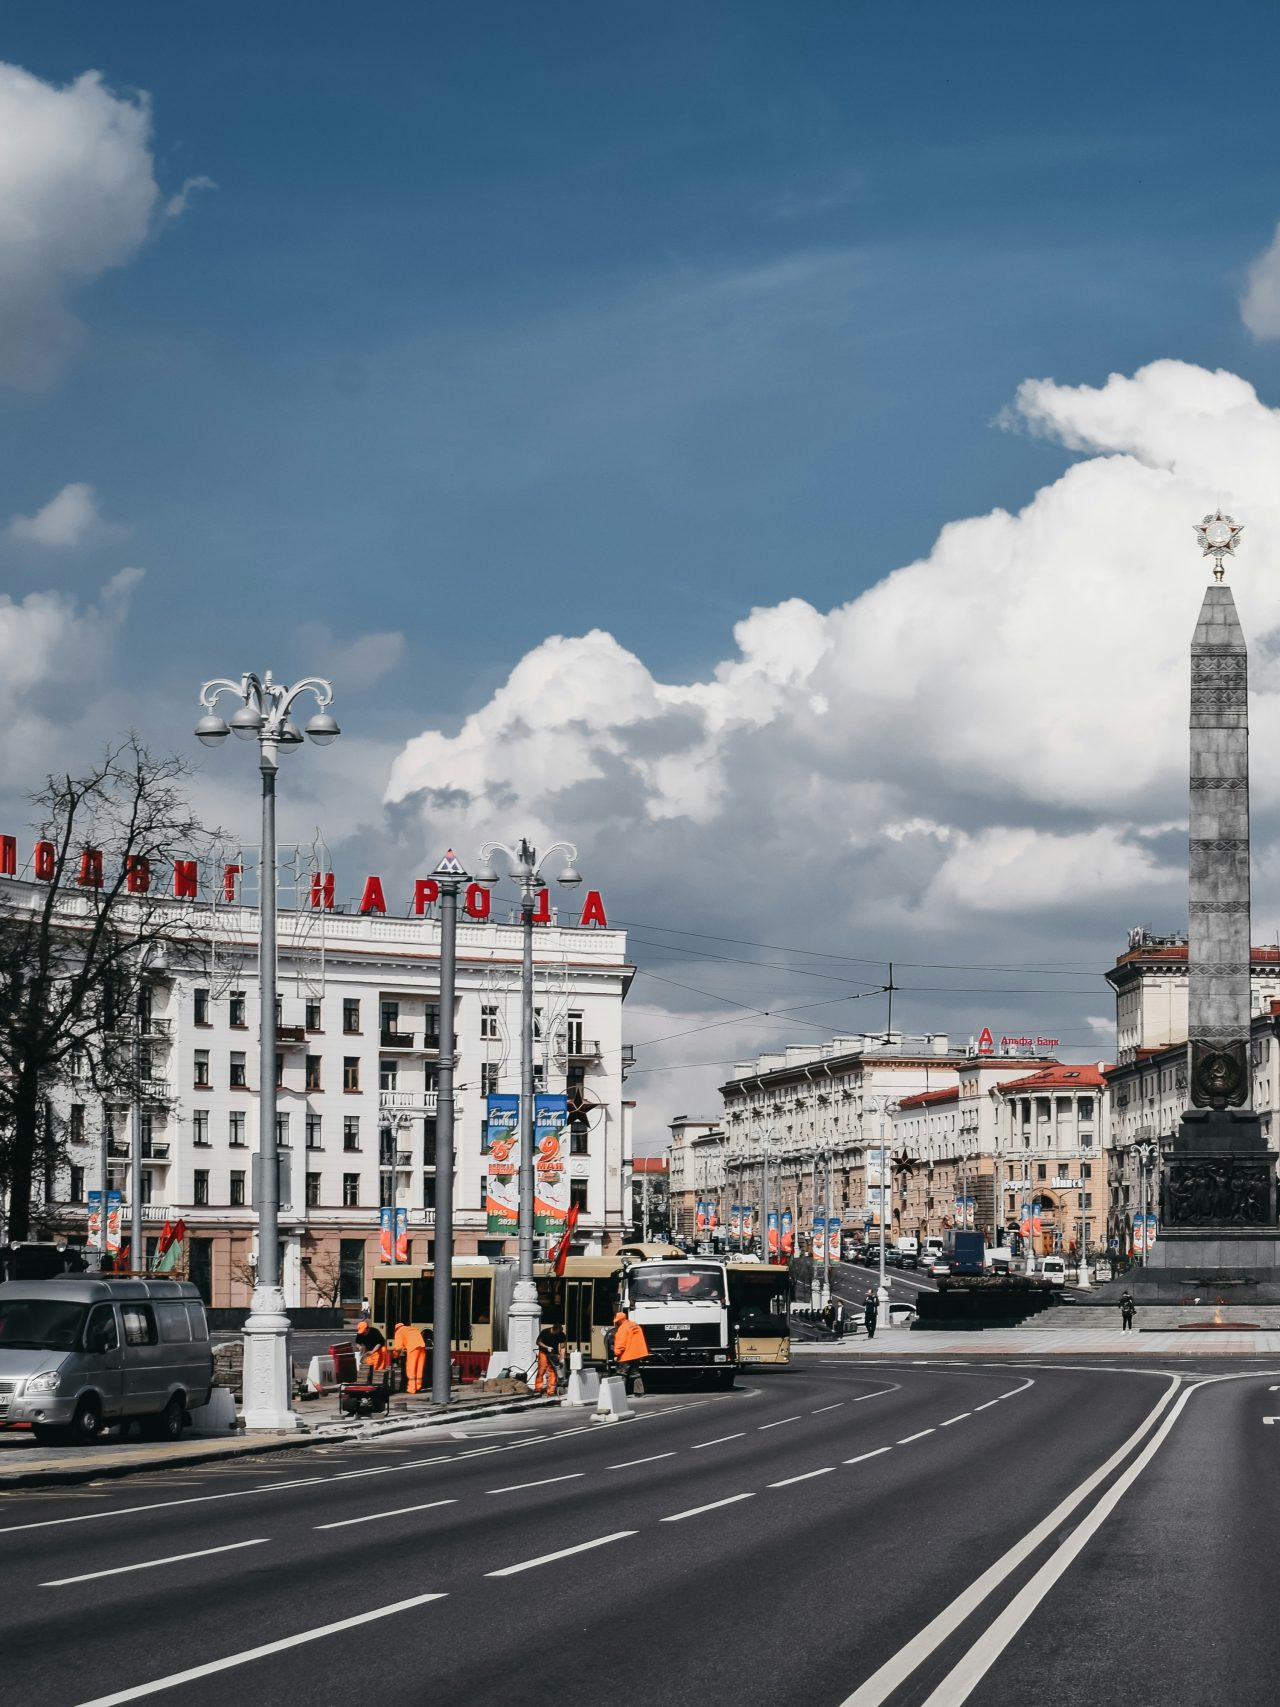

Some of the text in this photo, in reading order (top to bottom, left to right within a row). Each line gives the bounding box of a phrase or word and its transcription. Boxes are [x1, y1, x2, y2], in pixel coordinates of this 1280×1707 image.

[310, 872, 608, 926] НАРОДА
[539, 1136, 559, 1162] 9
[537, 1161, 564, 1171] МАЯ
